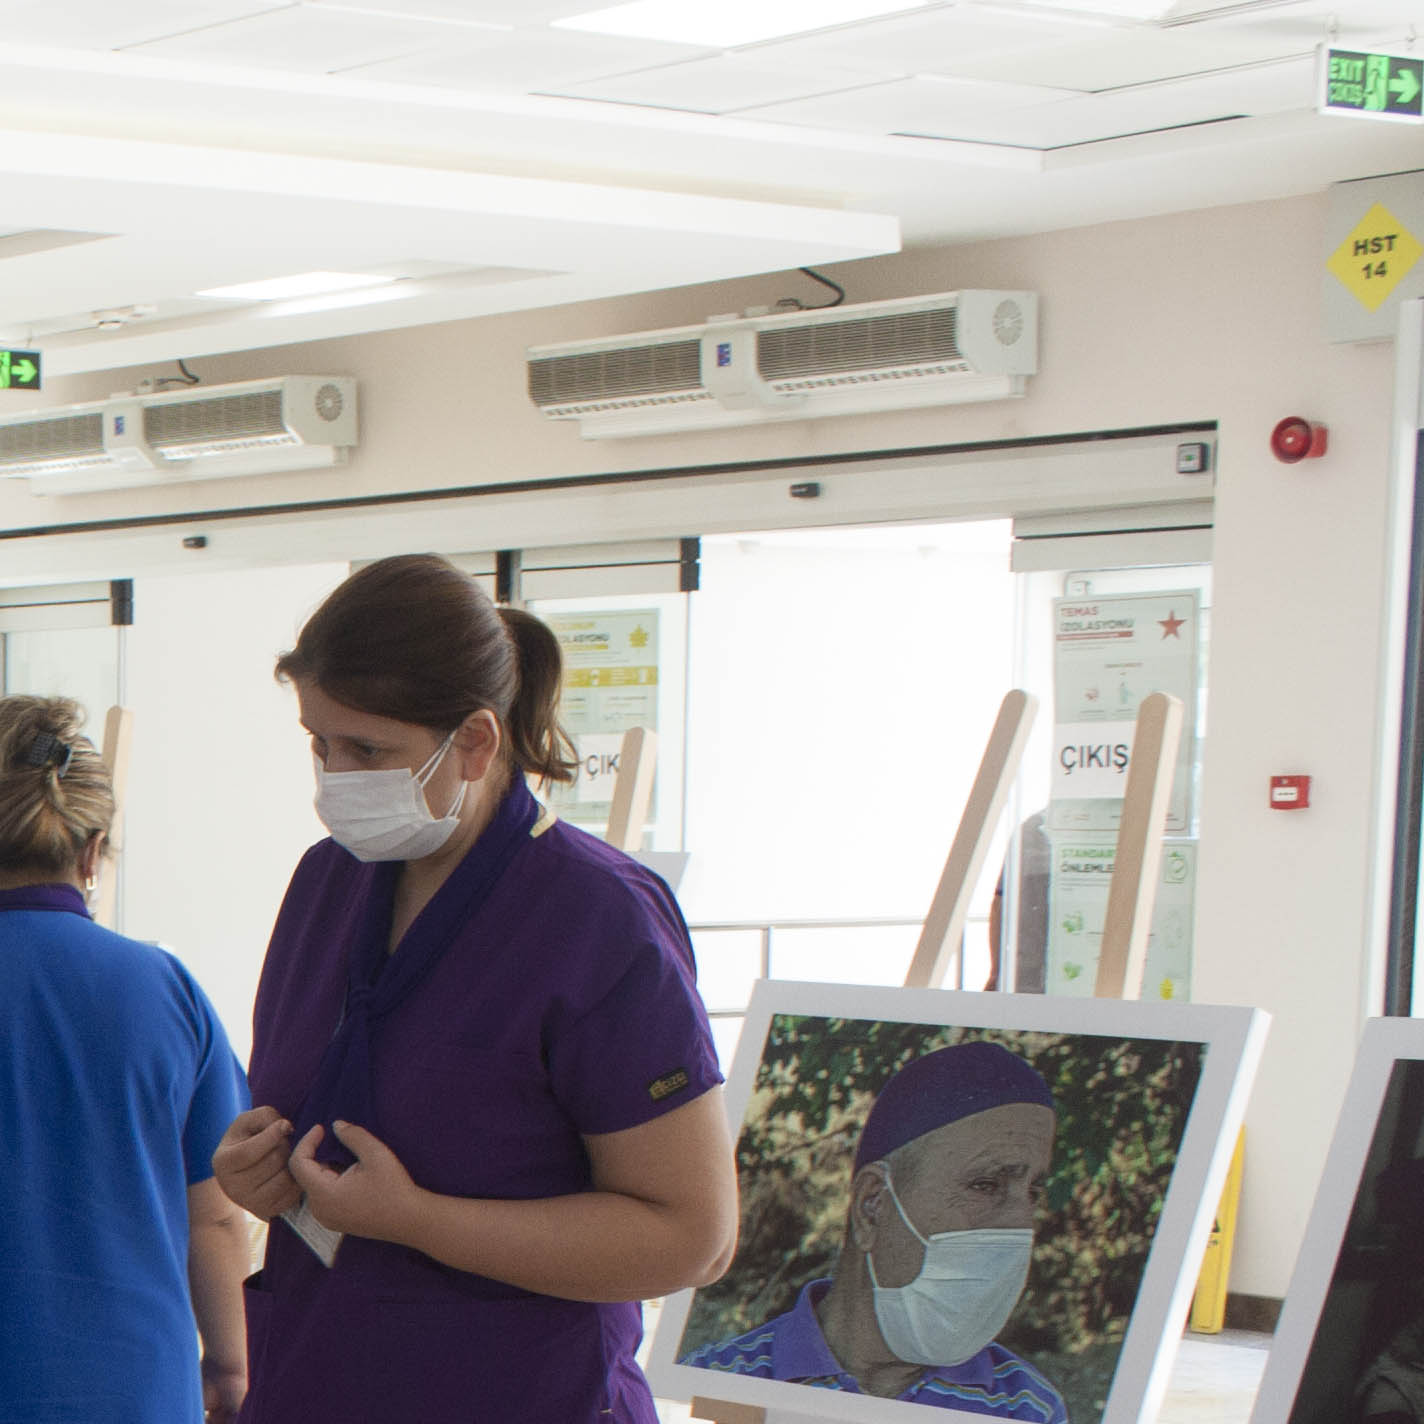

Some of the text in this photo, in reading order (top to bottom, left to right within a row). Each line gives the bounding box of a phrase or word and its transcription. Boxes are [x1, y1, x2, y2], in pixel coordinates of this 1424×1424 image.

[1353, 234, 1398, 256] HST
[1362, 261, 1387, 279] 14
[585, 754, 620, 781] ÇIK
[1060, 744, 1129, 776] ÇIKIŞ
[1060, 861, 1116, 873] ÖNLEMLE
